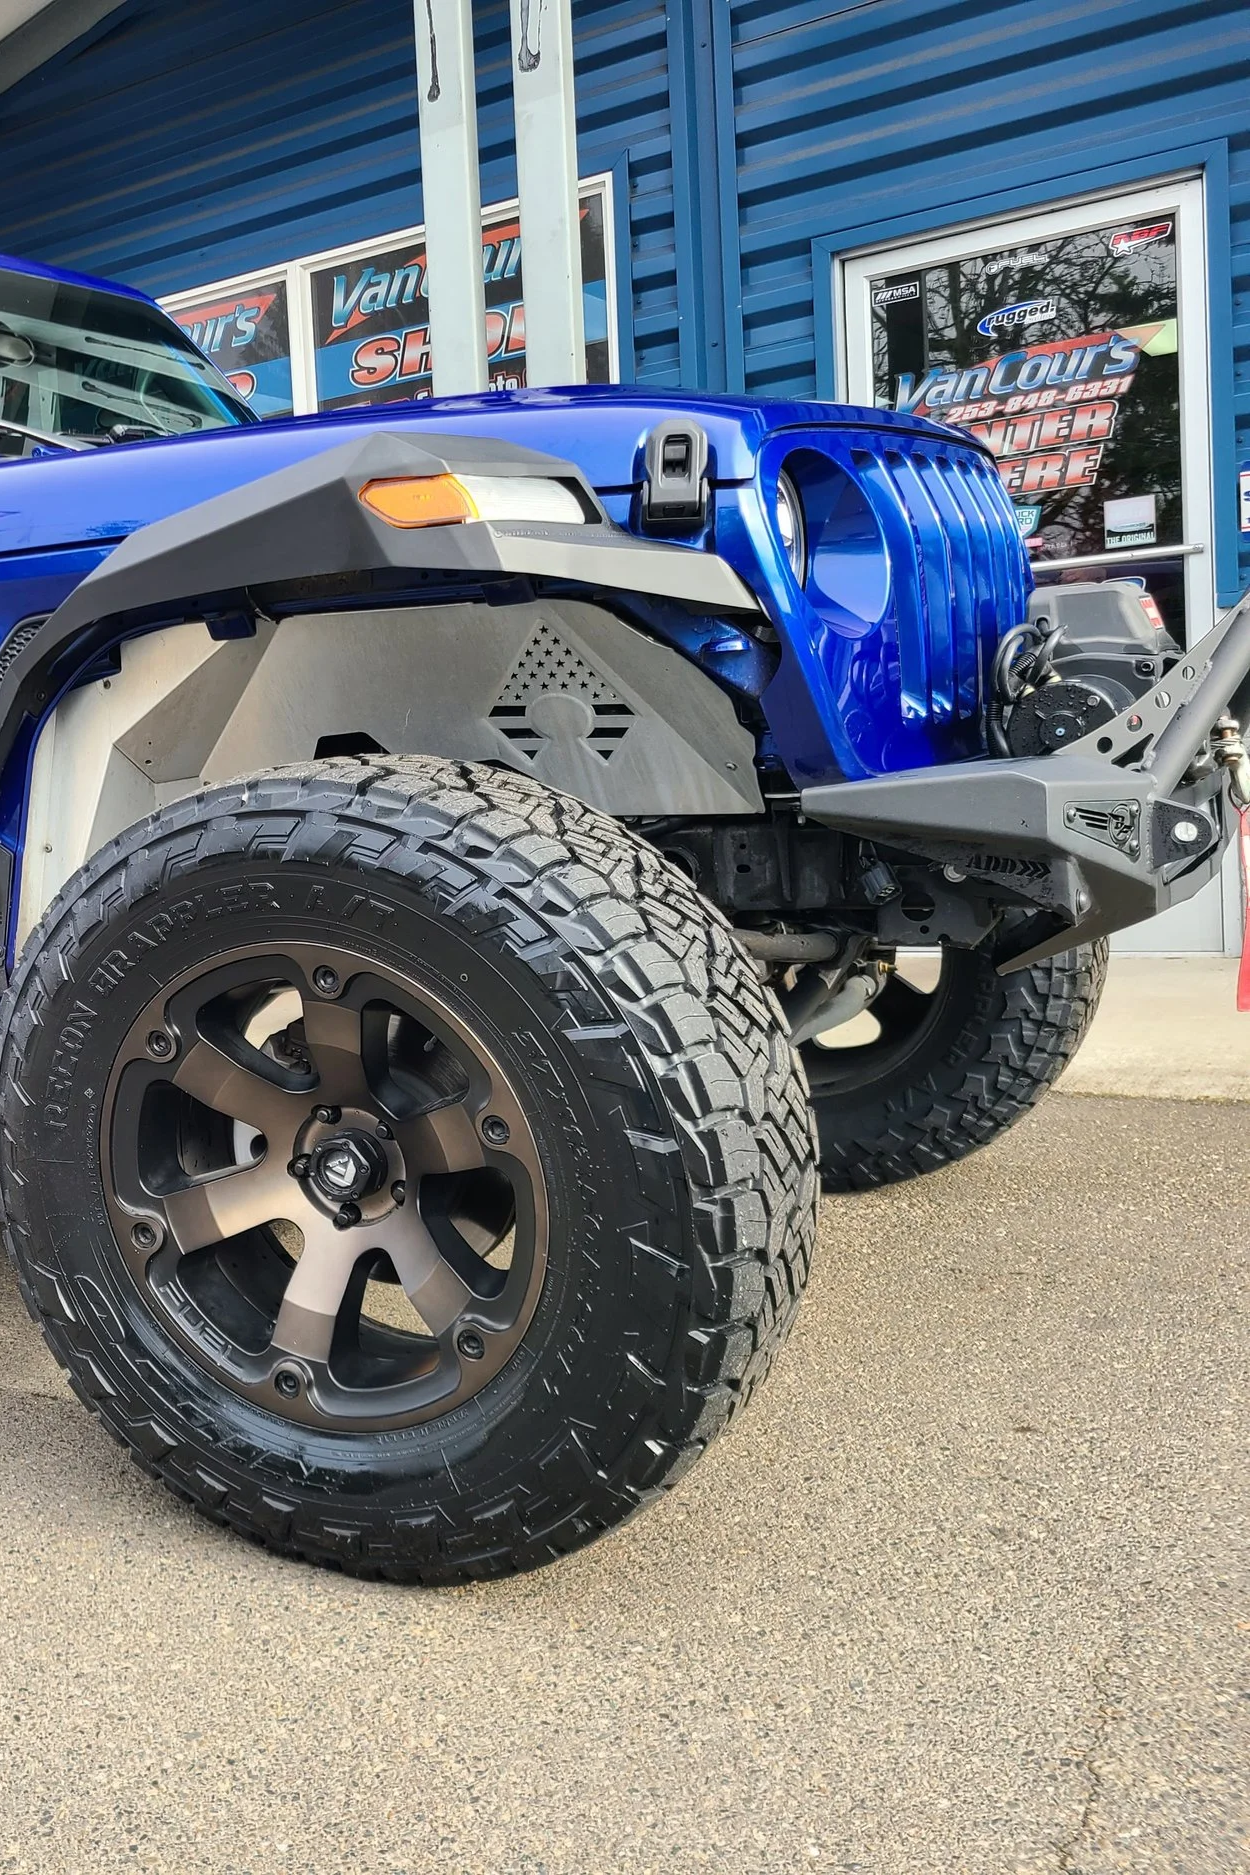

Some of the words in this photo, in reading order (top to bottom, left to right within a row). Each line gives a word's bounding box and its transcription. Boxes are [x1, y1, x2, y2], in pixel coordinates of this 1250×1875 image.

[893, 285, 916, 297] MSA
[896, 334, 1141, 414] VanCour's
[946, 375, 1136, 422] 253-848-6331
[969, 402, 1117, 454] NTER
[998, 446, 1101, 493] ERE
[159, 1281, 245, 1377] FUEL
